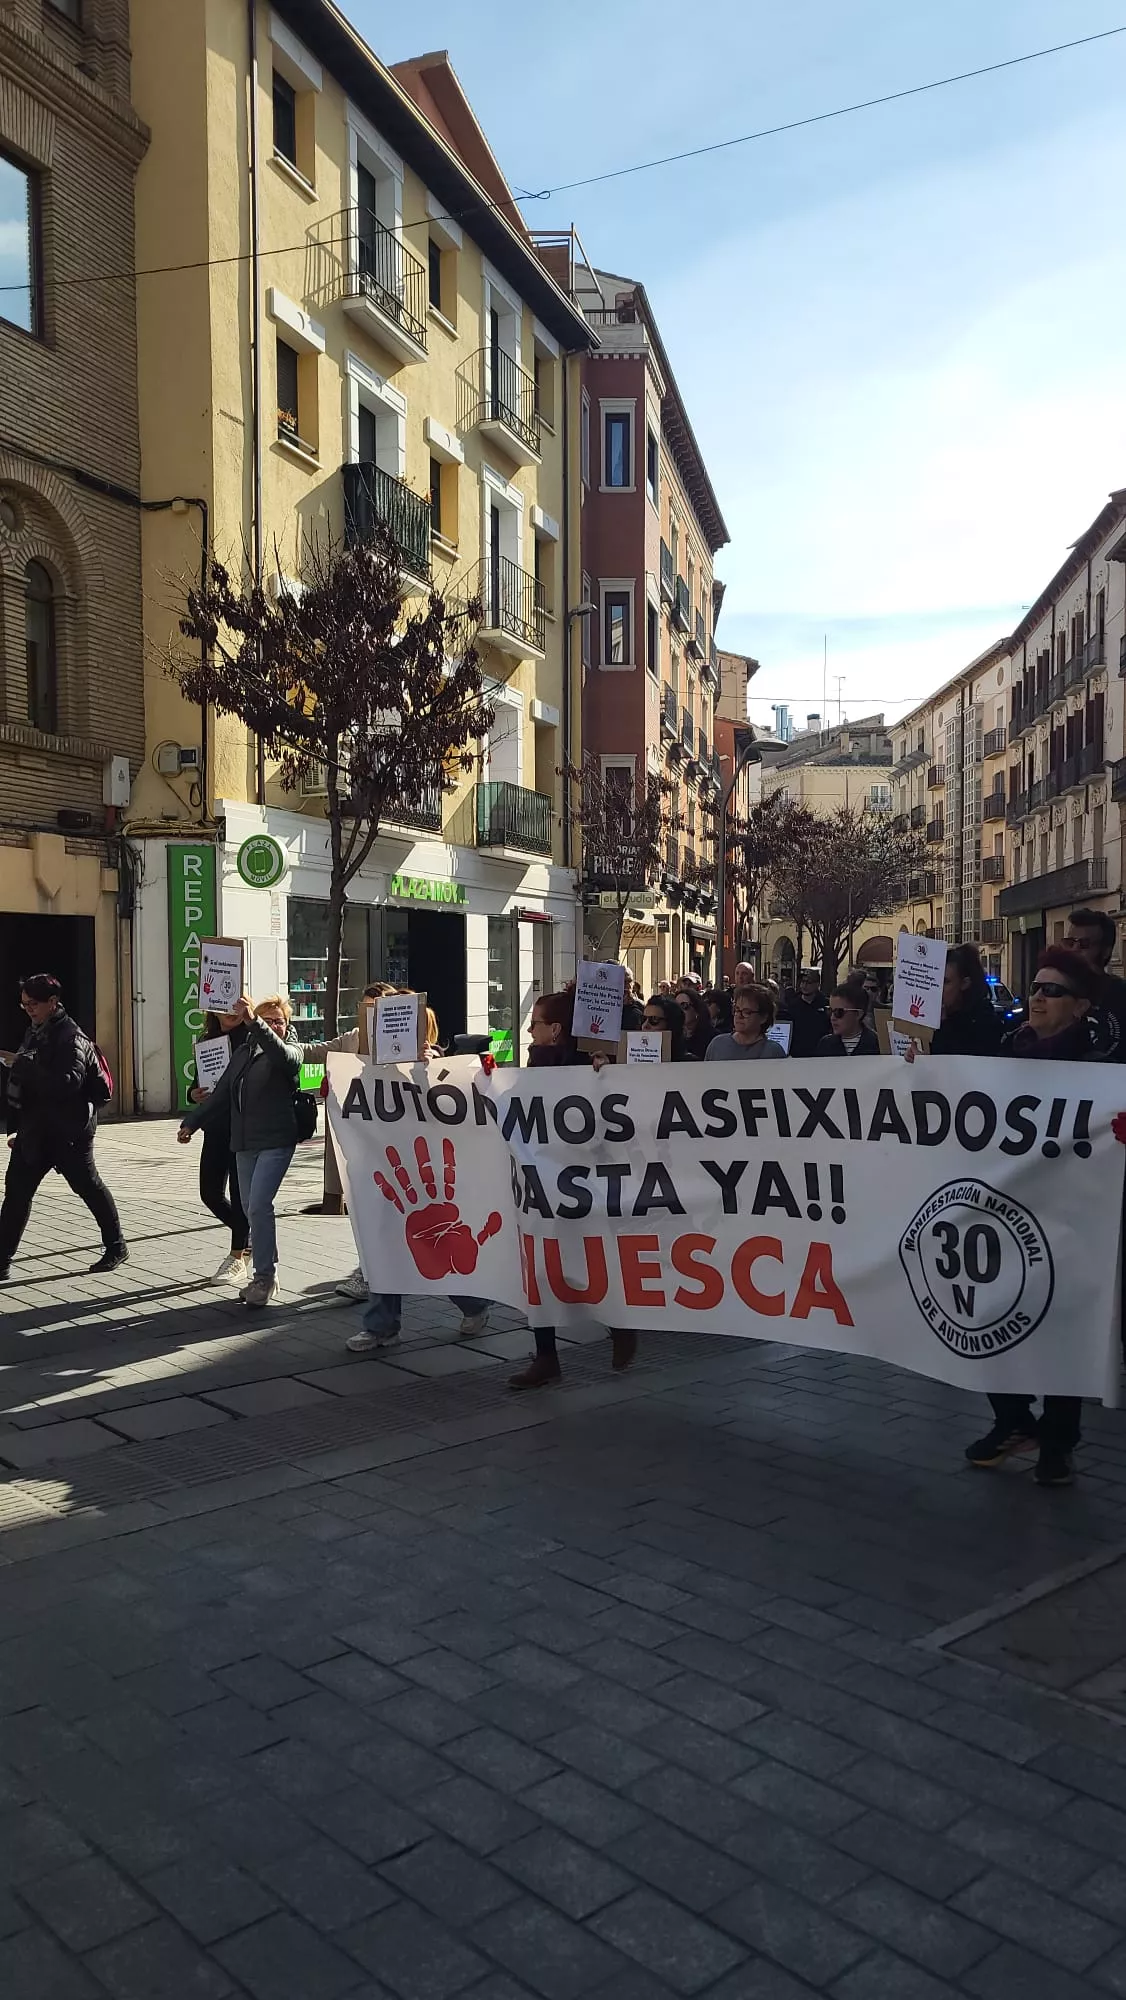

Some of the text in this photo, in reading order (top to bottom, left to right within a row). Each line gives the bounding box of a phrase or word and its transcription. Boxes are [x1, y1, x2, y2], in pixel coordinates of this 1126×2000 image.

[246, 840, 272, 851] PLAZA
[341, 1069, 1093, 1159] AUTÓNMOS ASFIXIADOS!!
[699, 1160, 847, 1225] YA!!
[904, 1183, 1043, 1267] MANIFESTACIÓN NACIONAL
[931, 1220, 1002, 1284] 30
[921, 1295, 1032, 1353] DE AUTÓNOMOS
[951, 1283, 976, 1318] N
